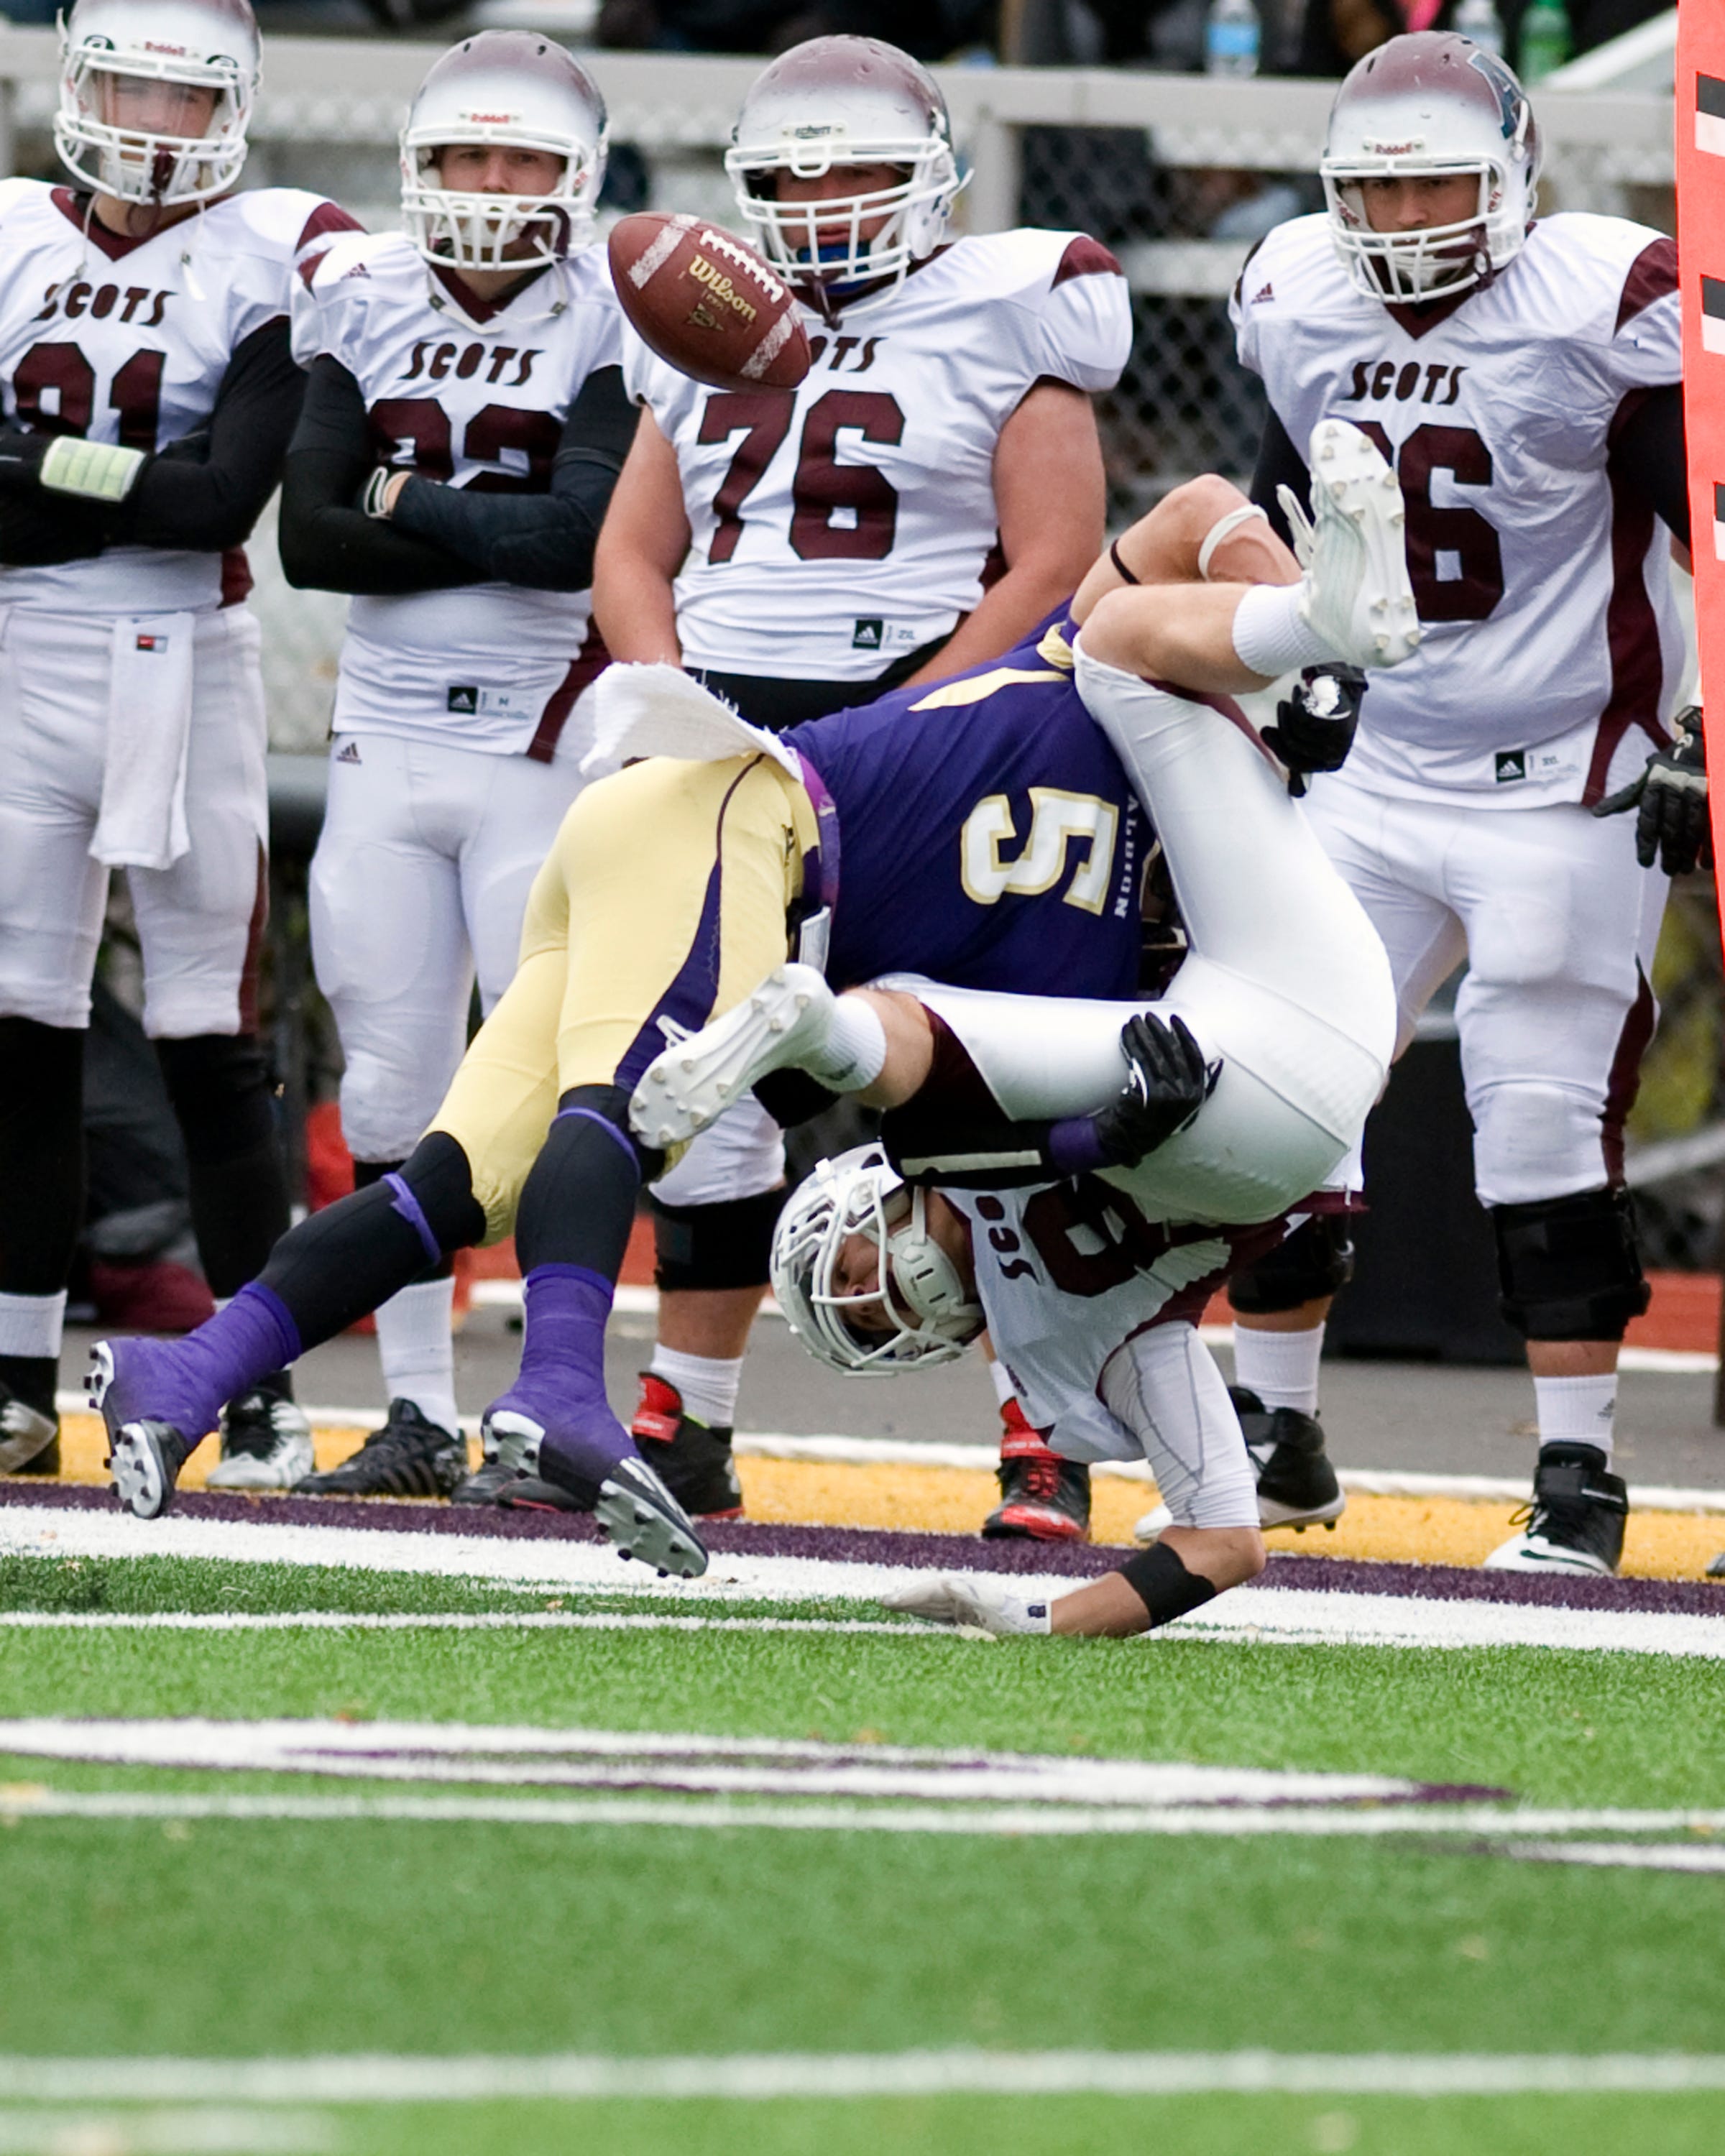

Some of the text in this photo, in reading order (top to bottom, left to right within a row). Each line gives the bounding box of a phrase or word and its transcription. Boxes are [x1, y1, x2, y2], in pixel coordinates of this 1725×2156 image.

[30, 282, 179, 327] SCOTS
[689, 254, 757, 323] Wilson
[395, 341, 546, 387] SCOTS
[808, 335, 889, 373] OTS
[1338, 360, 1470, 406] SCOTS
[696, 389, 906, 566] 76
[1353, 420, 1505, 621] 6
[960, 787, 1120, 917] 5
[1114, 793, 1140, 919] ALBION
[974, 1195, 1040, 1286] SCO
